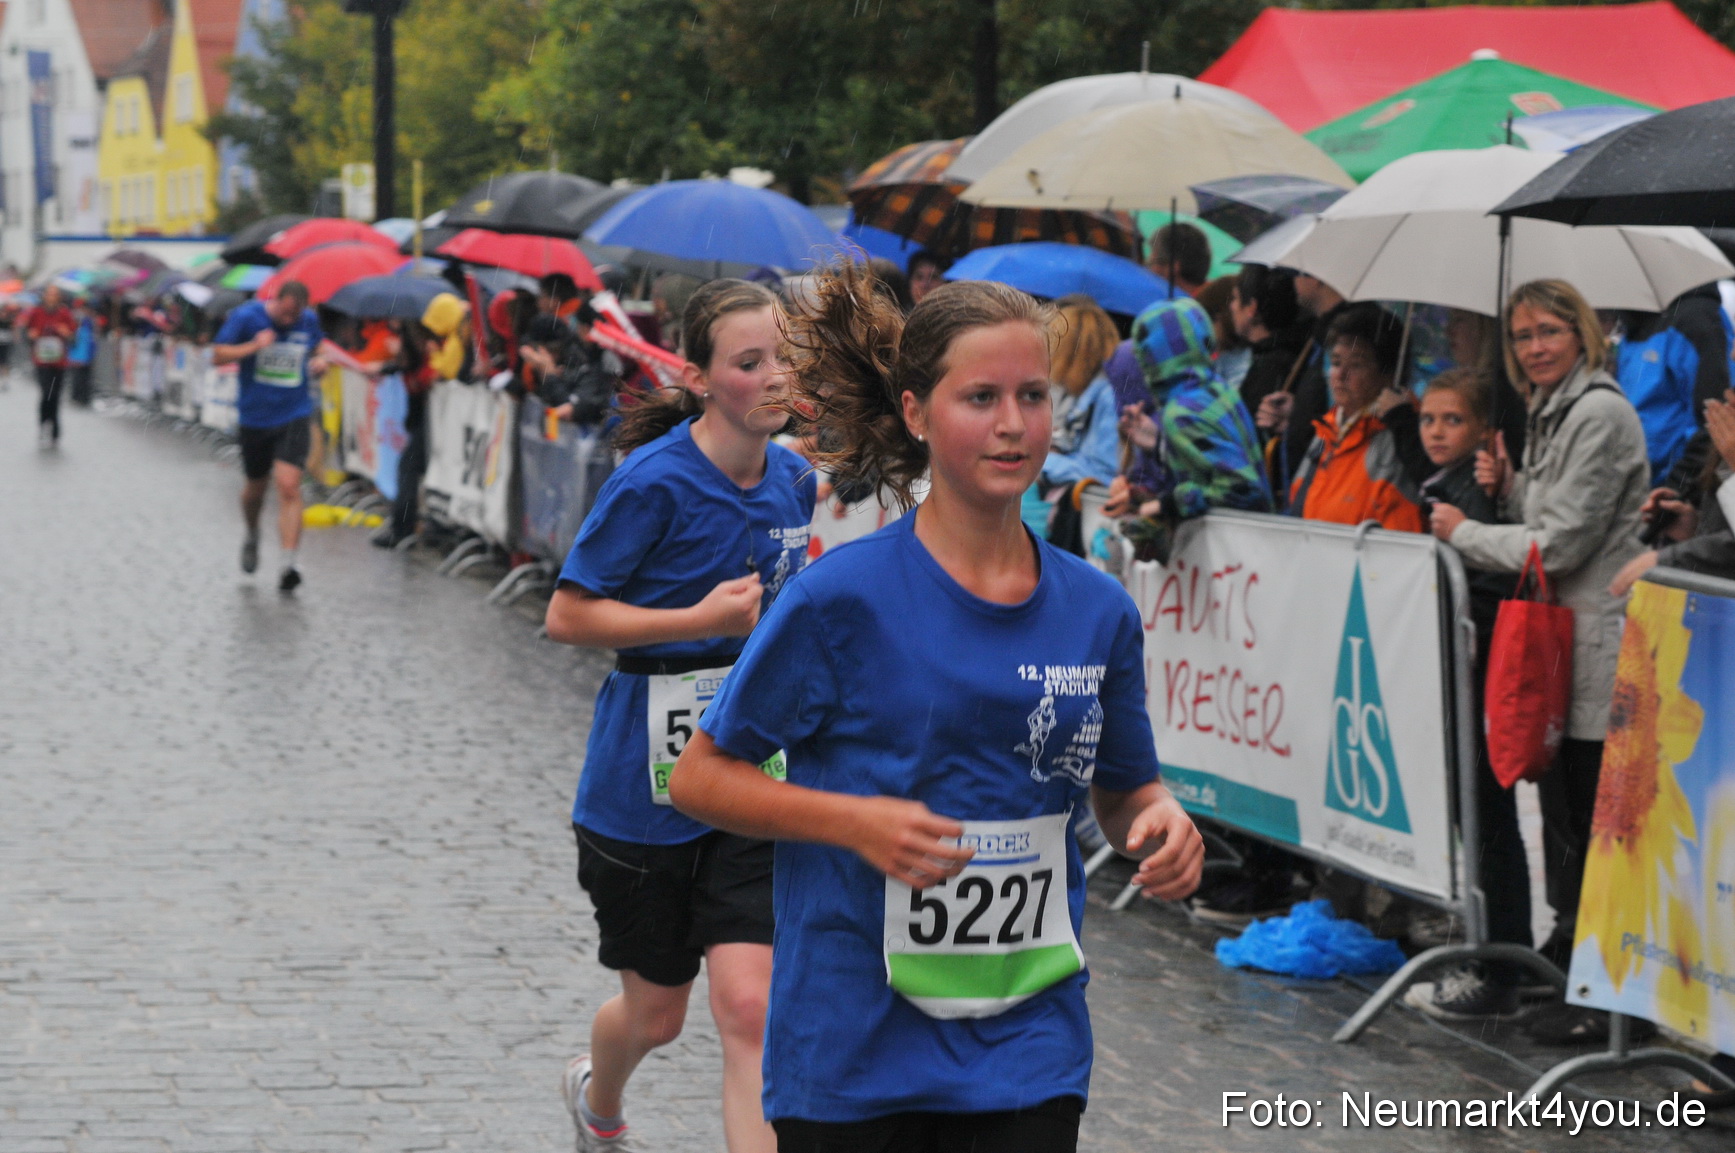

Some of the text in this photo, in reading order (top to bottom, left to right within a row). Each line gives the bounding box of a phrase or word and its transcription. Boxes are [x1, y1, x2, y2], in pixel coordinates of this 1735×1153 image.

[1017, 664, 1043, 681] 12.
[667, 708, 706, 757] 5
[1164, 657, 1292, 758] BESSER
[908, 868, 1053, 945] 5227
